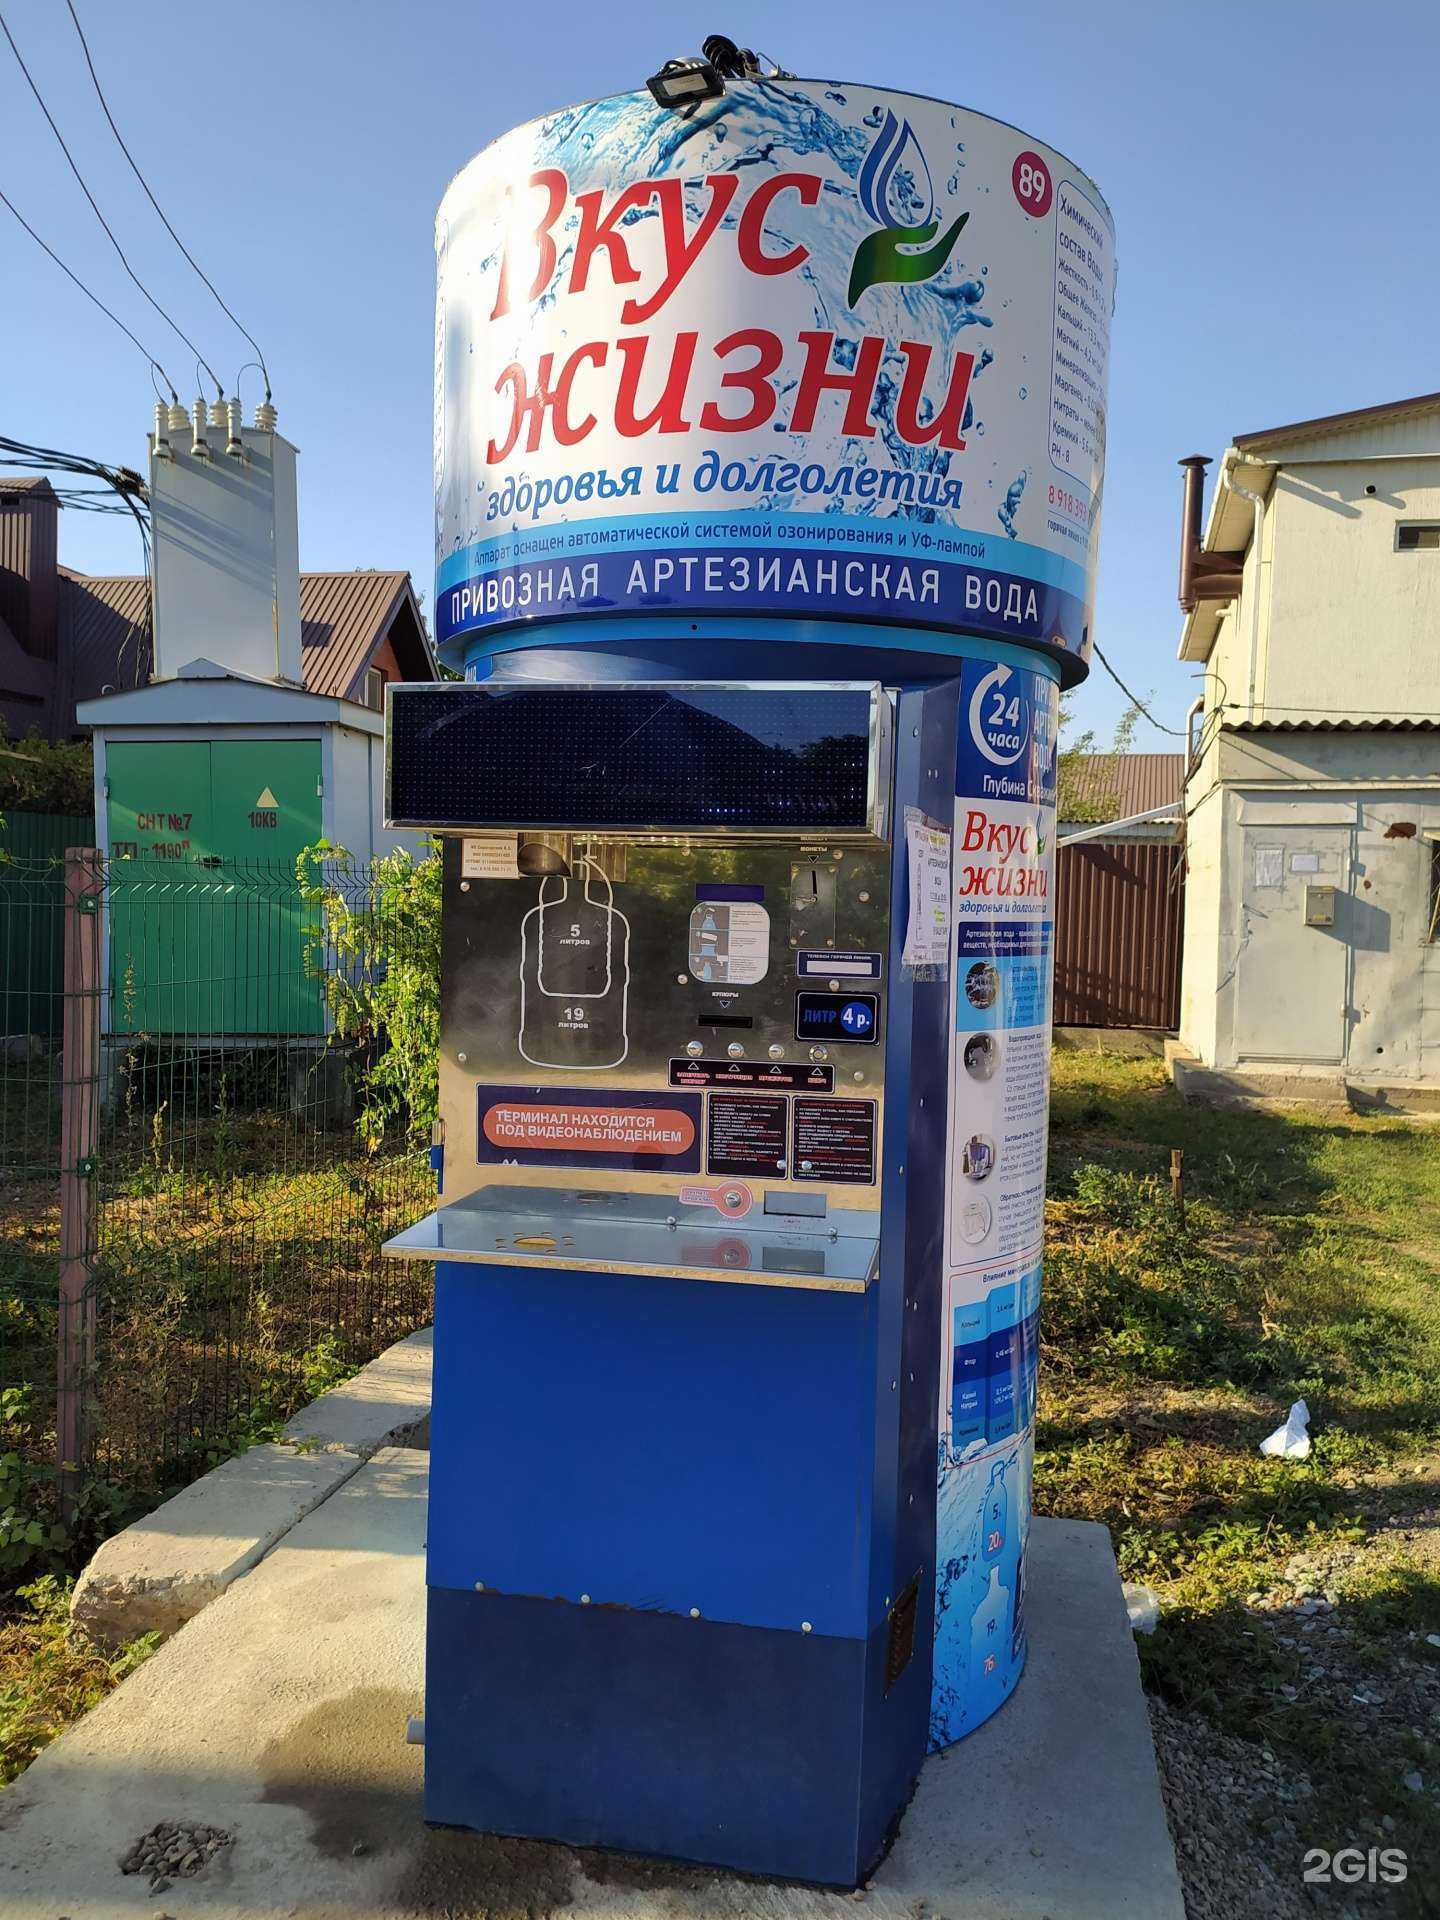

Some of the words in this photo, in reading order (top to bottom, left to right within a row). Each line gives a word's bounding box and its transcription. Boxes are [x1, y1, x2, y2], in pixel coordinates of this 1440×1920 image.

[1019, 164, 1046, 203] 89
[1060, 194, 1104, 248] Химический
[490, 168, 821, 325] Вкус
[1059, 231, 1086, 263] состав
[1058, 280, 1079, 306] Общее
[1057, 304, 1083, 331] Кальций
[1056, 326, 1080, 352] Магний
[486, 328, 975, 464] жизни
[1054, 373, 1084, 404] Марганец
[1053, 396, 1079, 422] Нитраты
[1052, 418, 1079, 445] Кремний
[487, 466, 643, 521] здоровья
[655, 463, 681, 494] и
[693, 450, 964, 511] долголетия
[1048, 485, 1055, 504] 8
[1057, 488, 1073, 513] 918
[474, 545, 512, 567] Аппарат
[513, 535, 564, 556] оснащен
[568, 520, 690, 548] автоматической
[694, 520, 772, 540] системой
[777, 523, 894, 547] озонирования
[898, 532, 907, 547] и
[911, 531, 986, 559] УФ-лампой
[451, 562, 600, 625] ПРИВОЗНАЯ
[626, 556, 940, 604] АРТЕЗИАНСКАЯ
[965, 574, 1039, 625] ВОДА
[988, 693, 1020, 728] 24
[987, 730, 1021, 751] часа
[983, 774, 1026, 798] Глубина
[137, 813, 164, 831] СНТ
[961, 810, 1032, 865] Вкус
[959, 865, 1048, 897] жизни
[959, 900, 1003, 916] здоровья
[559, 938, 591, 946] литров
[570, 924, 581, 937] 5
[963, 942, 988, 950] веществ,
[557, 1021, 589, 1030] литров
[563, 1007, 584, 1021] 19
[803, 1008, 837, 1024] ЛИТР
[842, 1007, 854, 1025] 4
[856, 1013, 870, 1029] р.
[495, 1109, 569, 1124] ТЕРМИНАЛ
[571, 1113, 656, 1129] НАХОДИТСЯ
[495, 1123, 526, 1137] ПОД
[527, 1125, 683, 1143] ВИДЕОНАБЛЮДЕНИЕМ
